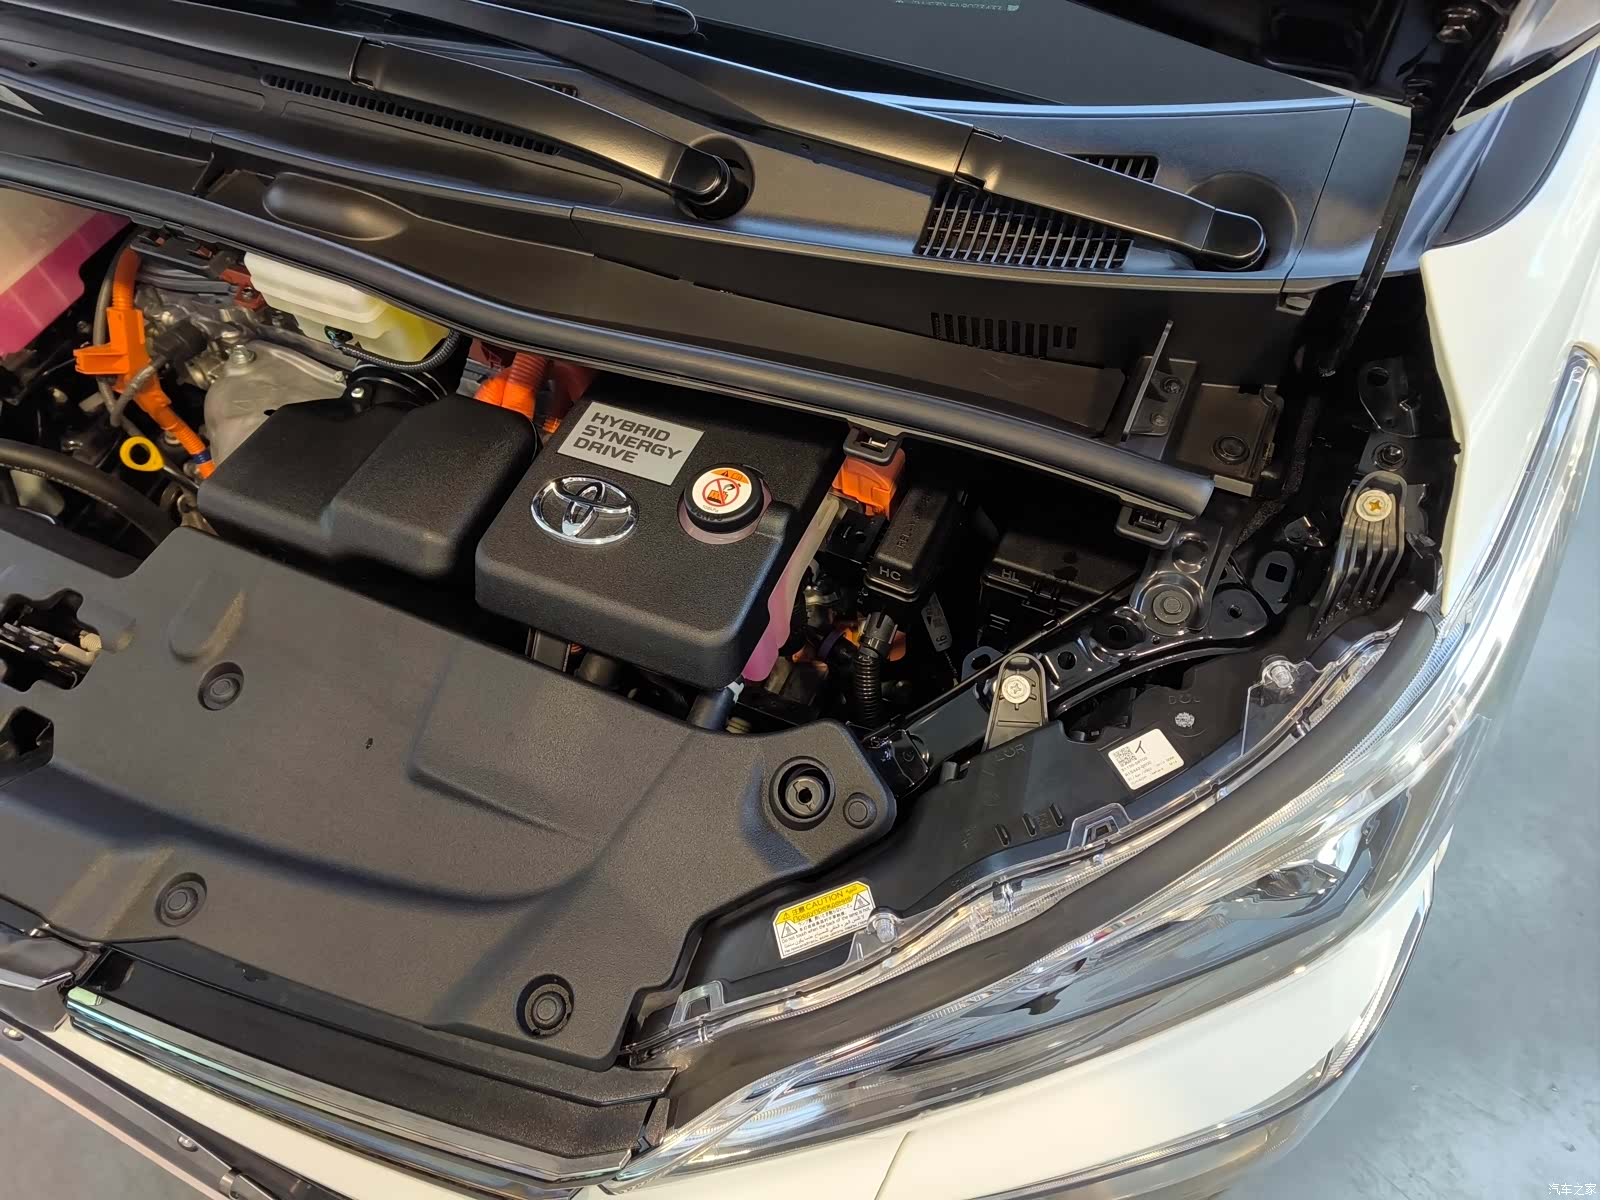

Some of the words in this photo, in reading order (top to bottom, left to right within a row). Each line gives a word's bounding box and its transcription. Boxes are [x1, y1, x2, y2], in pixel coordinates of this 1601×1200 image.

[591, 412, 671, 442] HYBRID
[573, 437, 638, 463] DRIVE
[582, 424, 682, 459] SYNERGY
[879, 566, 901, 581] HC
[805, 891, 844, 911] CAUTION
